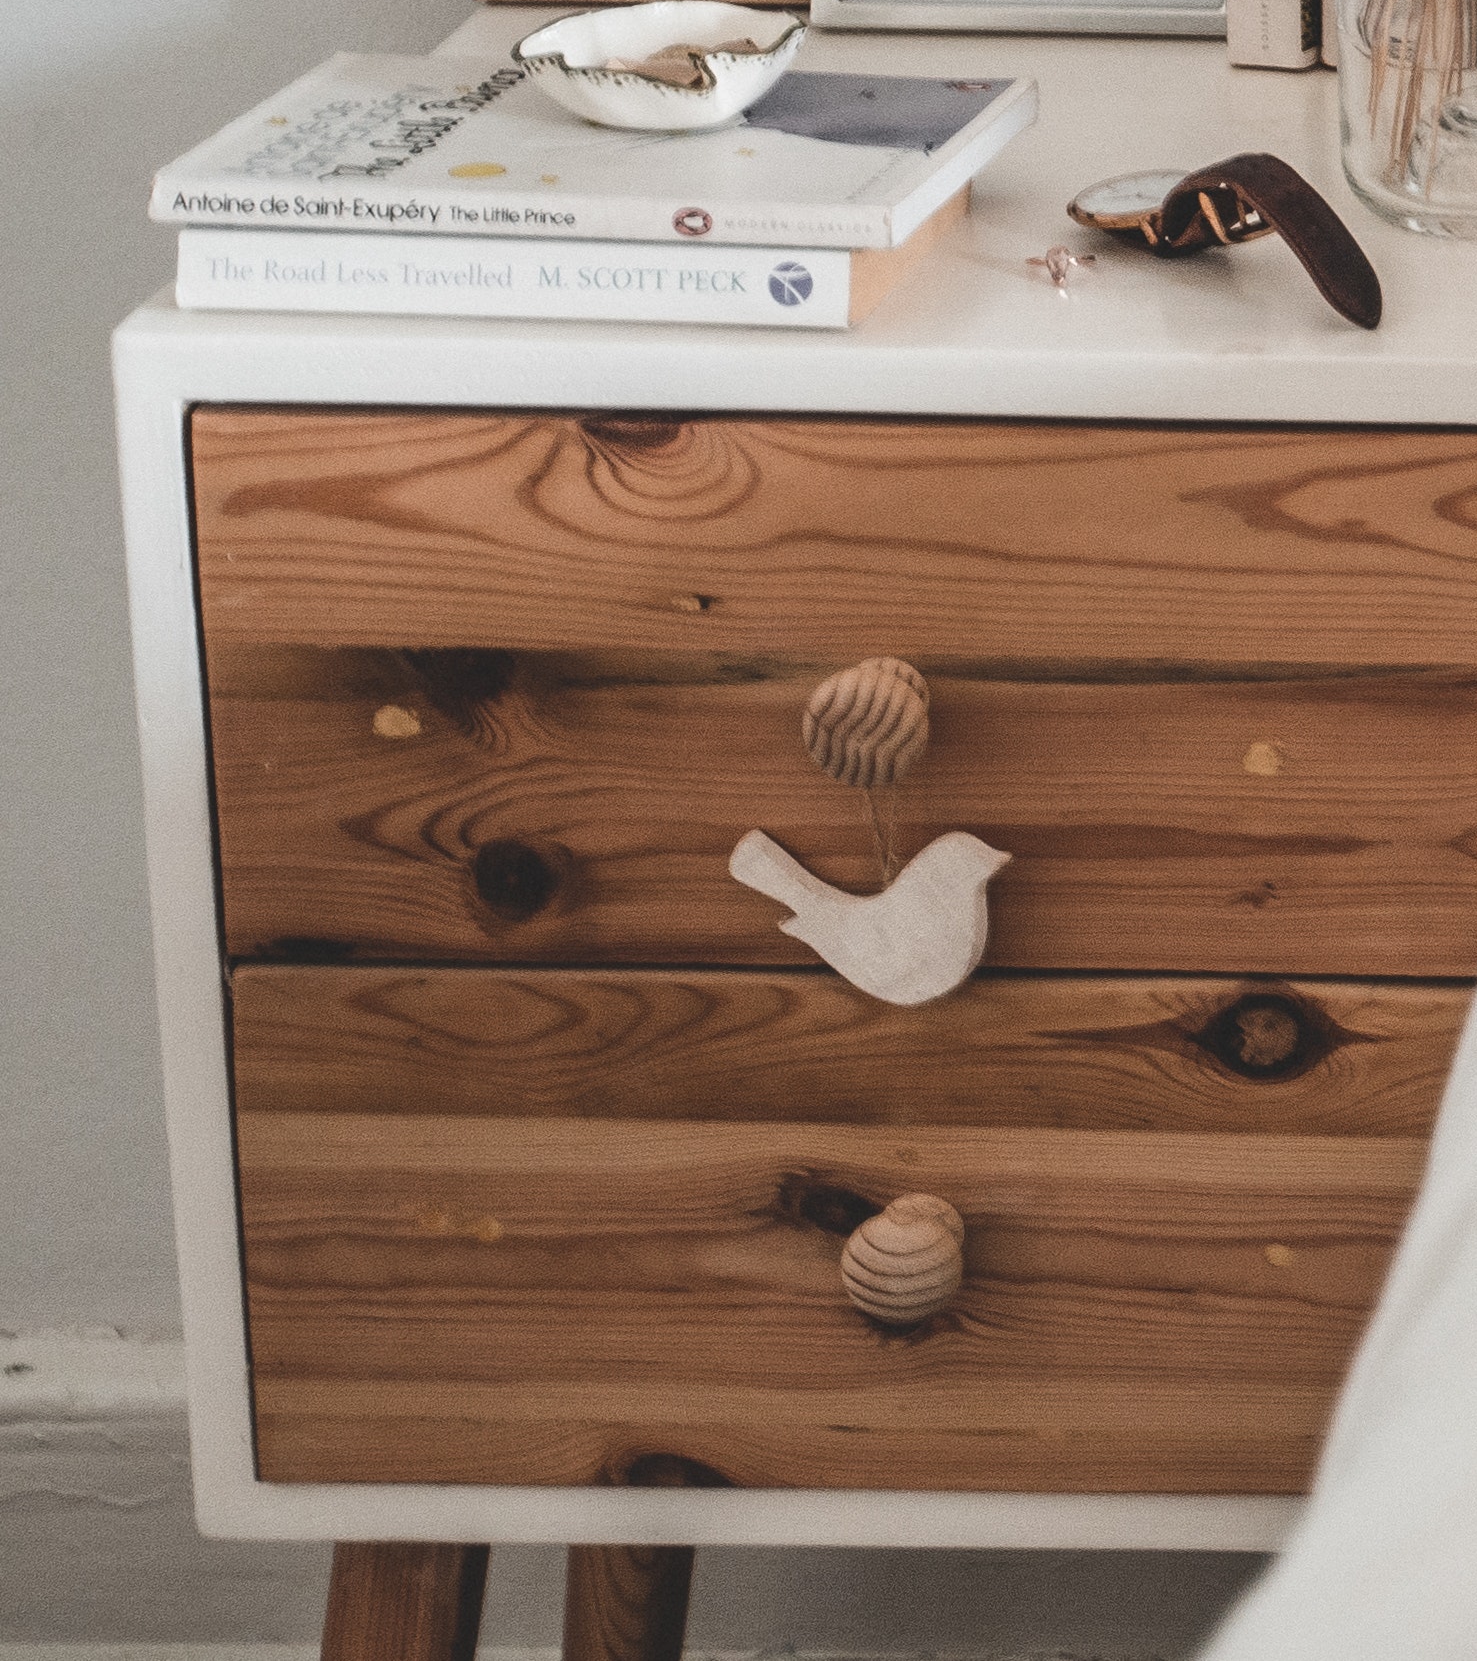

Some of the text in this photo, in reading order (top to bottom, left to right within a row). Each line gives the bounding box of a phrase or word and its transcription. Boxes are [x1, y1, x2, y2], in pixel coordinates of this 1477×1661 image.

[172, 191, 576, 226] Antoine de Saint-Exupéry The Little Prince
[724, 219, 788, 230] MODERN
[206, 257, 747, 292] The Road Less Travelled M. SCOTT PECK
